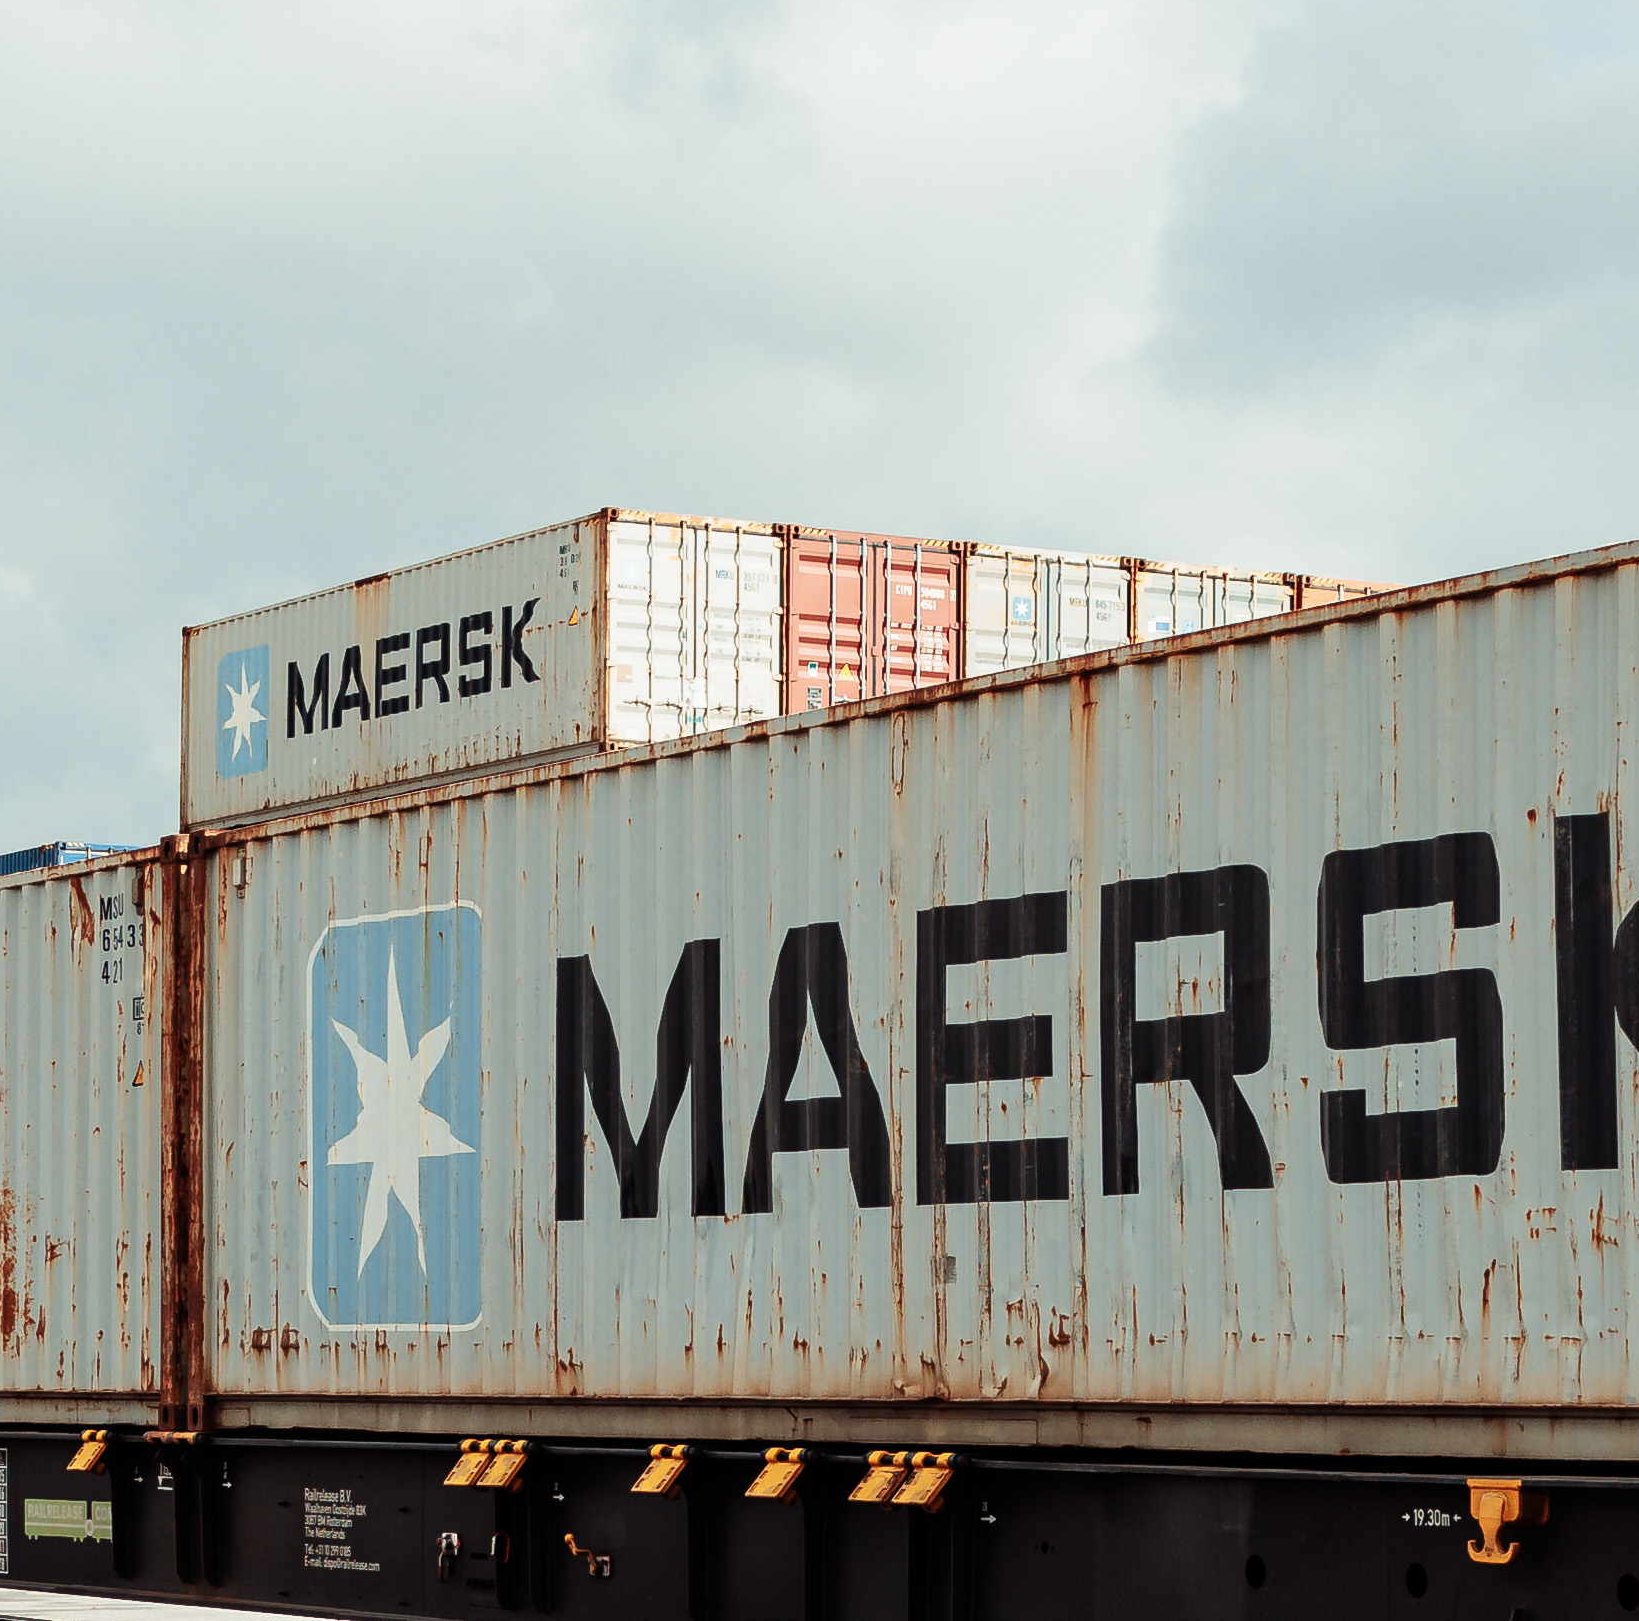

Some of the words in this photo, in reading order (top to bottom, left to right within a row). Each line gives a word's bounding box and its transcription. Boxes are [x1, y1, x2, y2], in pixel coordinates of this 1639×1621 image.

[287, 597, 541, 738] MAERSK
[27, 1503, 84, 1520] RAILRELEASE
[1413, 1508, 1451, 1528] 19.30m
